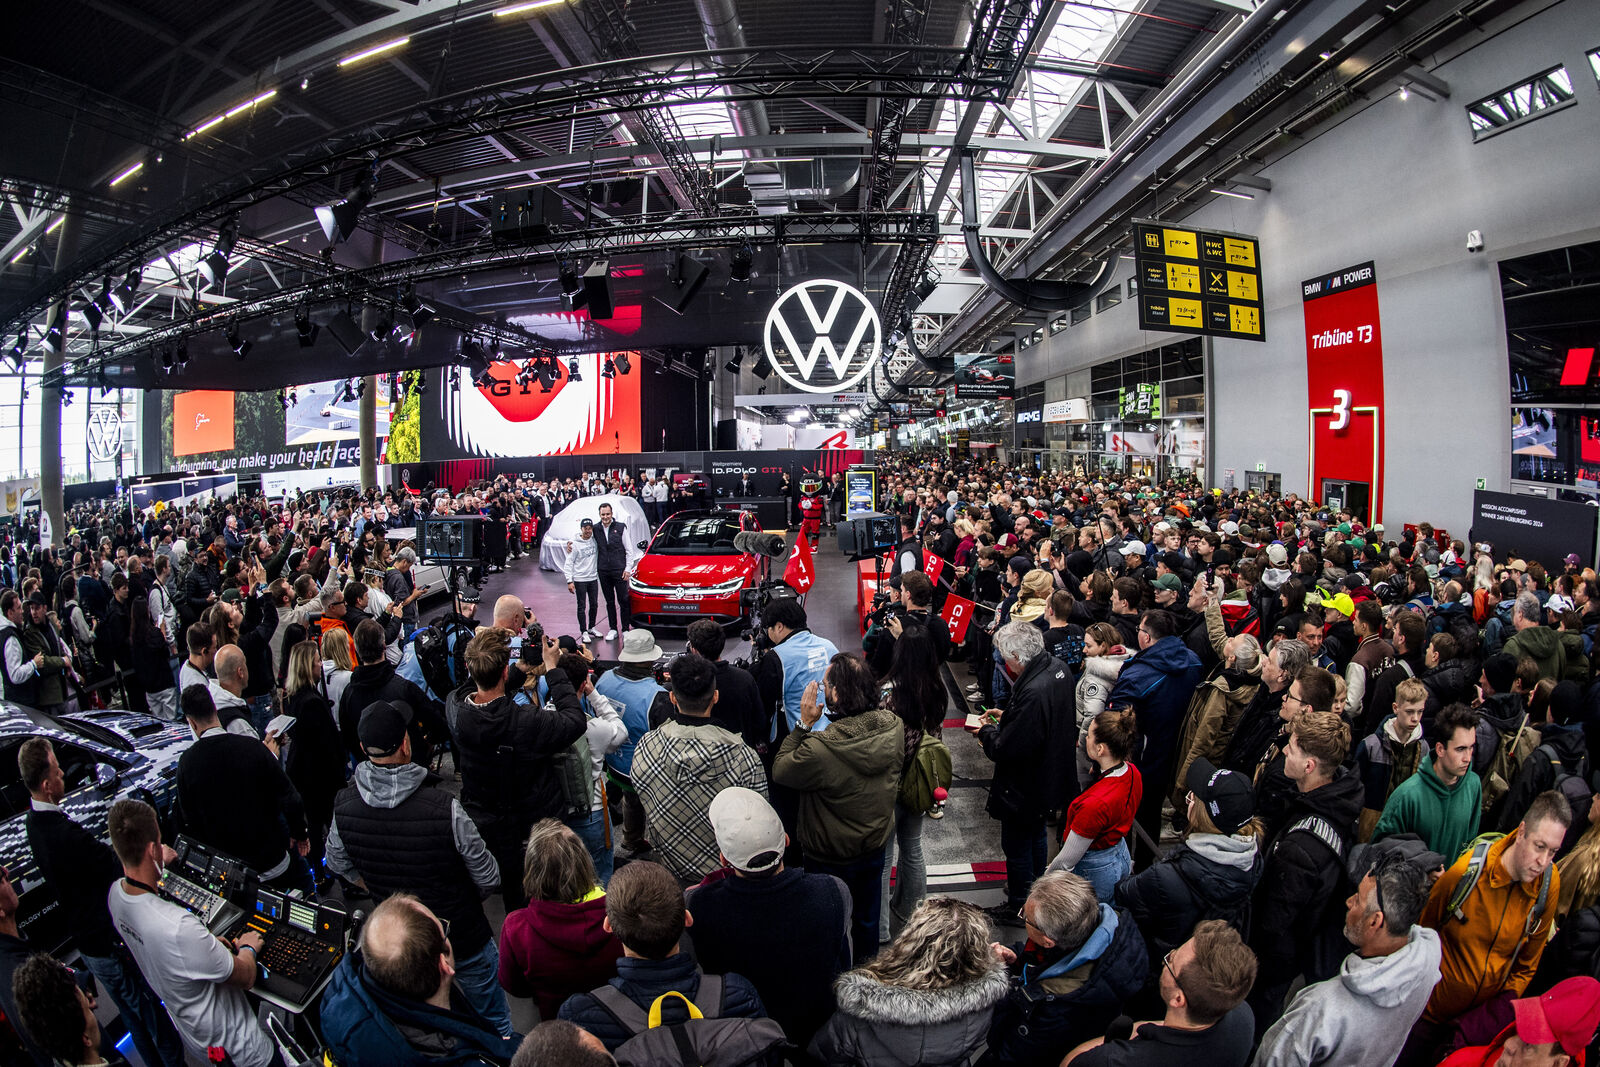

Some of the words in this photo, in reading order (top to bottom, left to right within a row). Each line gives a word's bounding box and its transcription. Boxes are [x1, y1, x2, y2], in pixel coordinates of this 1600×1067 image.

[1304, 281, 1322, 296] BMW
[1343, 267, 1372, 285] POWER
[1312, 328, 1354, 350] Tribüne
[1356, 324, 1373, 344] T3
[1022, 410, 1040, 422] AMG
[1328, 389, 1352, 430] 3
[222, 458, 236, 470] we
[238, 451, 267, 468] make
[270, 449, 297, 470] your
[298, 445, 332, 463] heart
[1480, 512, 1496, 520] WINNER
